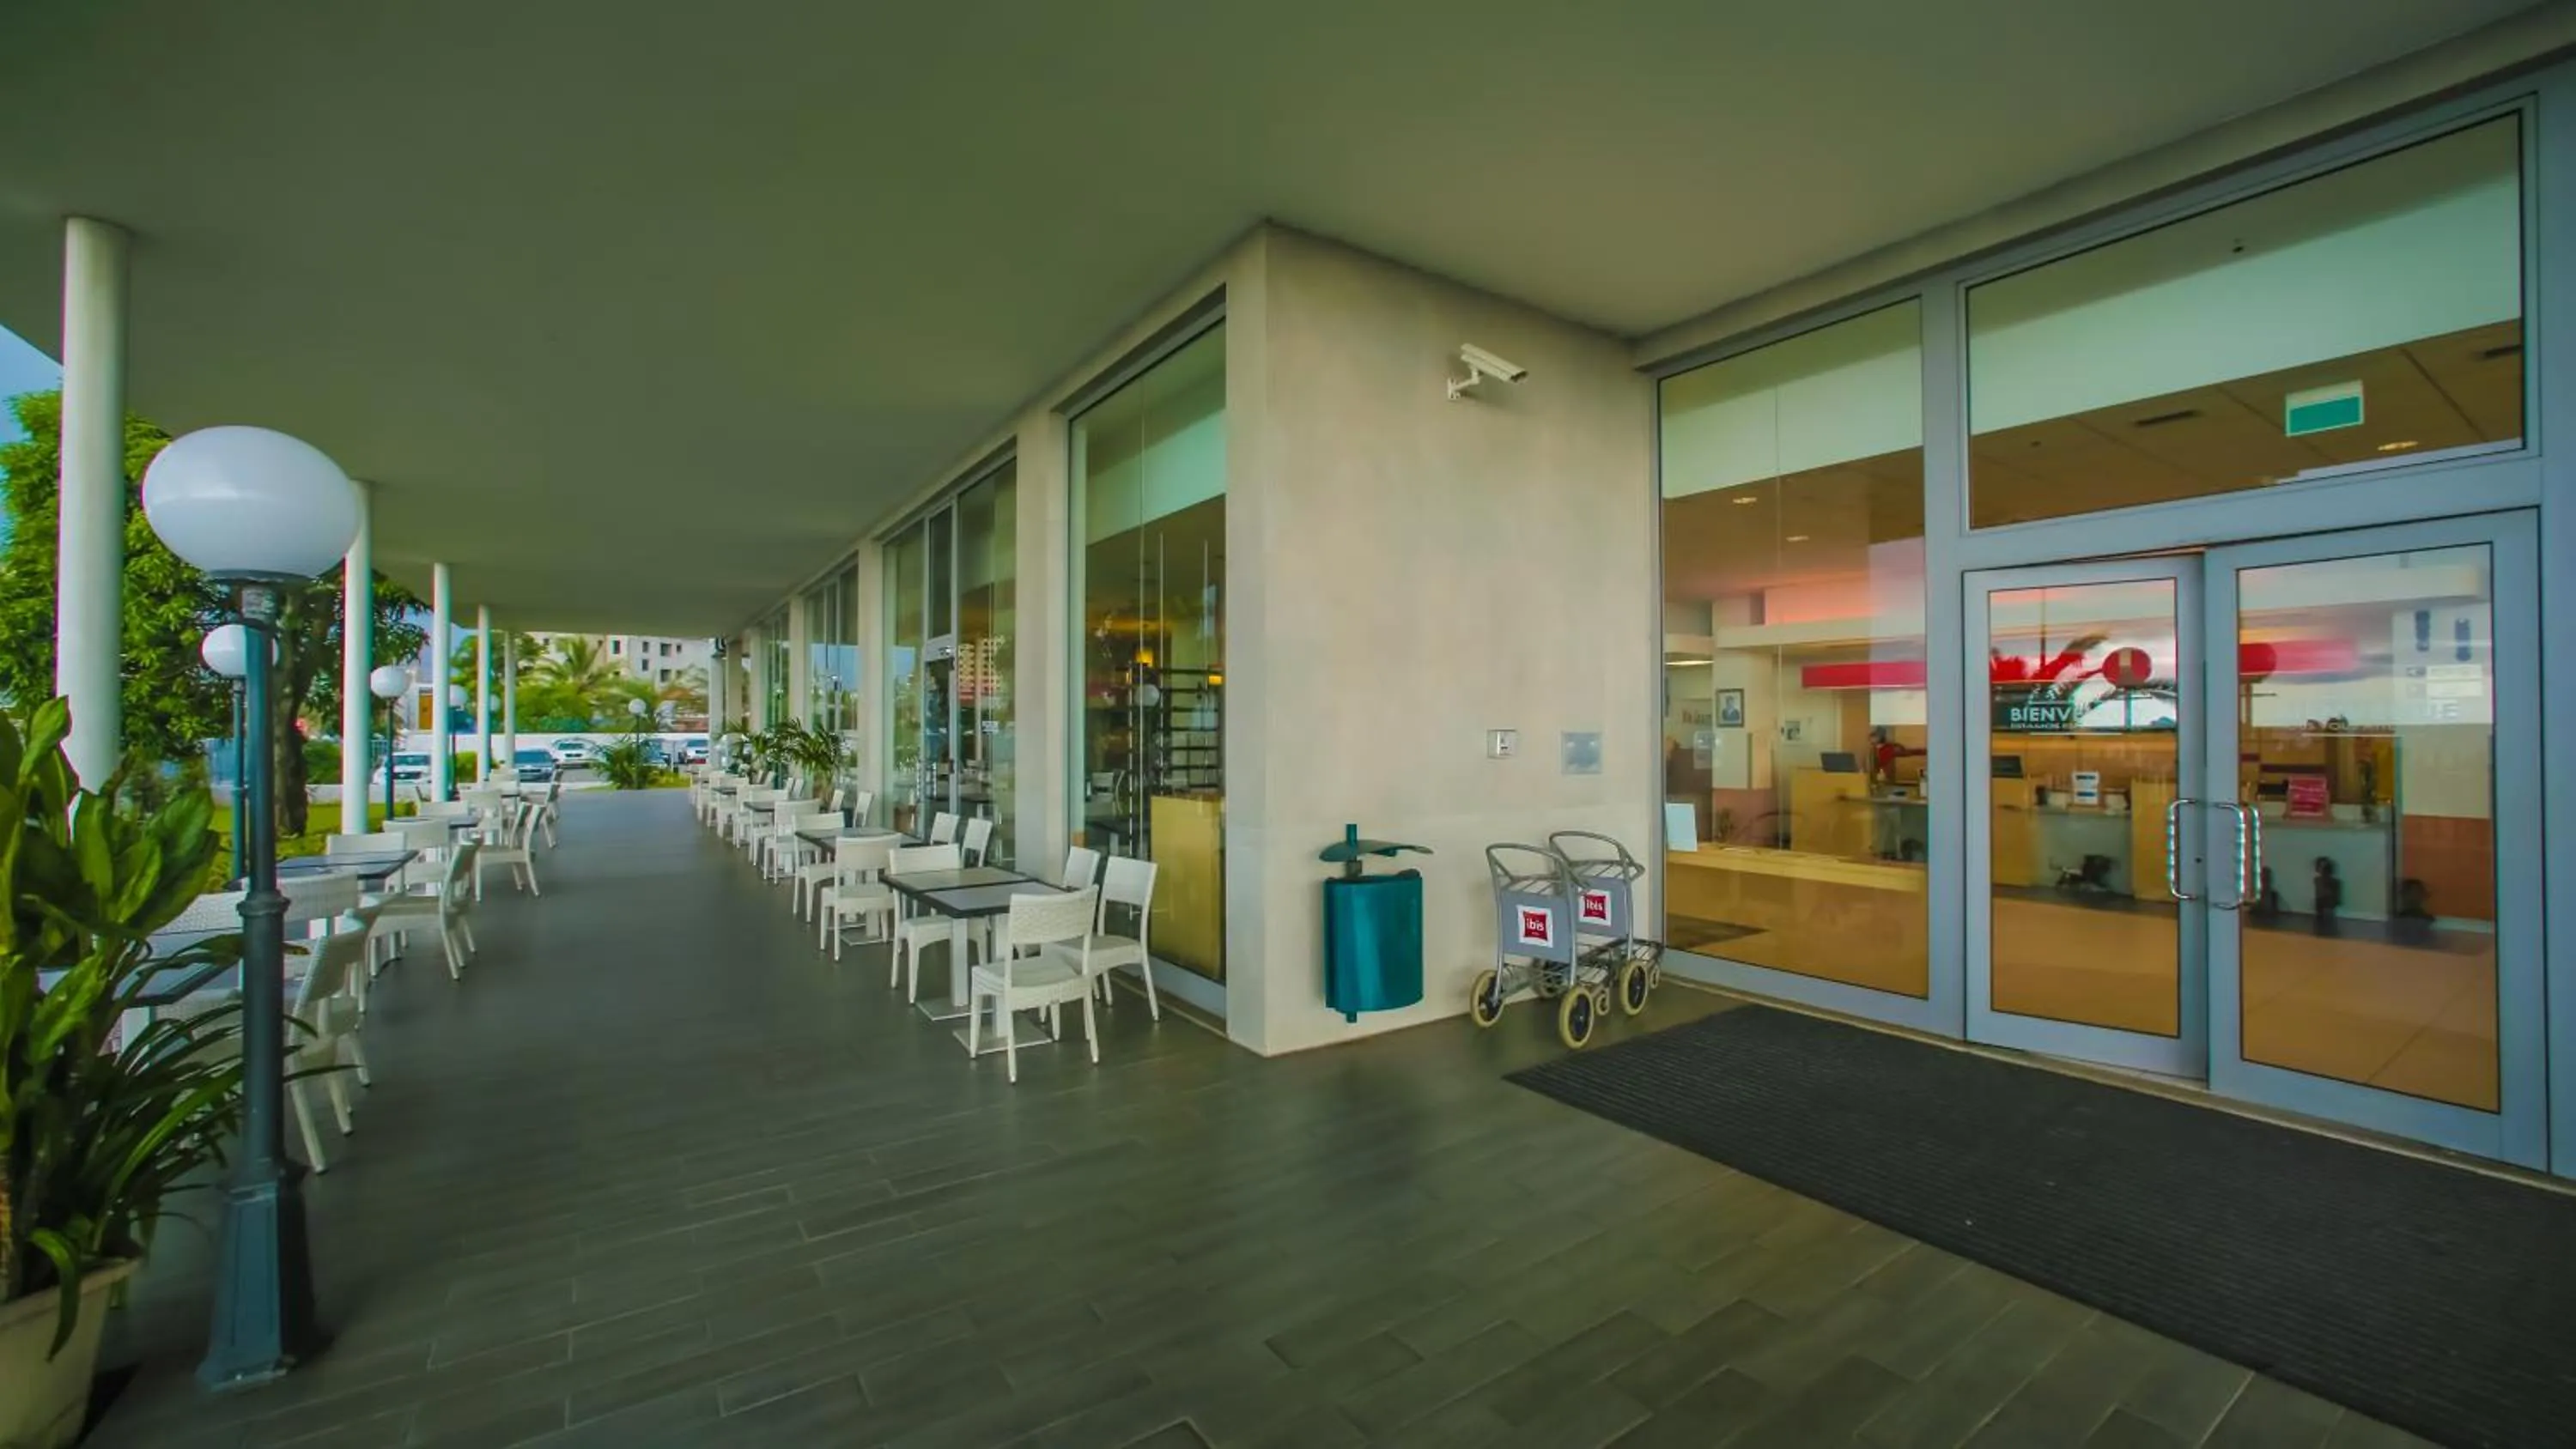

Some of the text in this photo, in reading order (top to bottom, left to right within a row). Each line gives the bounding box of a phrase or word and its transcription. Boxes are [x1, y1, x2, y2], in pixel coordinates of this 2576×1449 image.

[2010, 706, 2081, 722] BIENV
[1586, 900, 1602, 911] ibis
[1527, 919, 1544, 931] ibis
